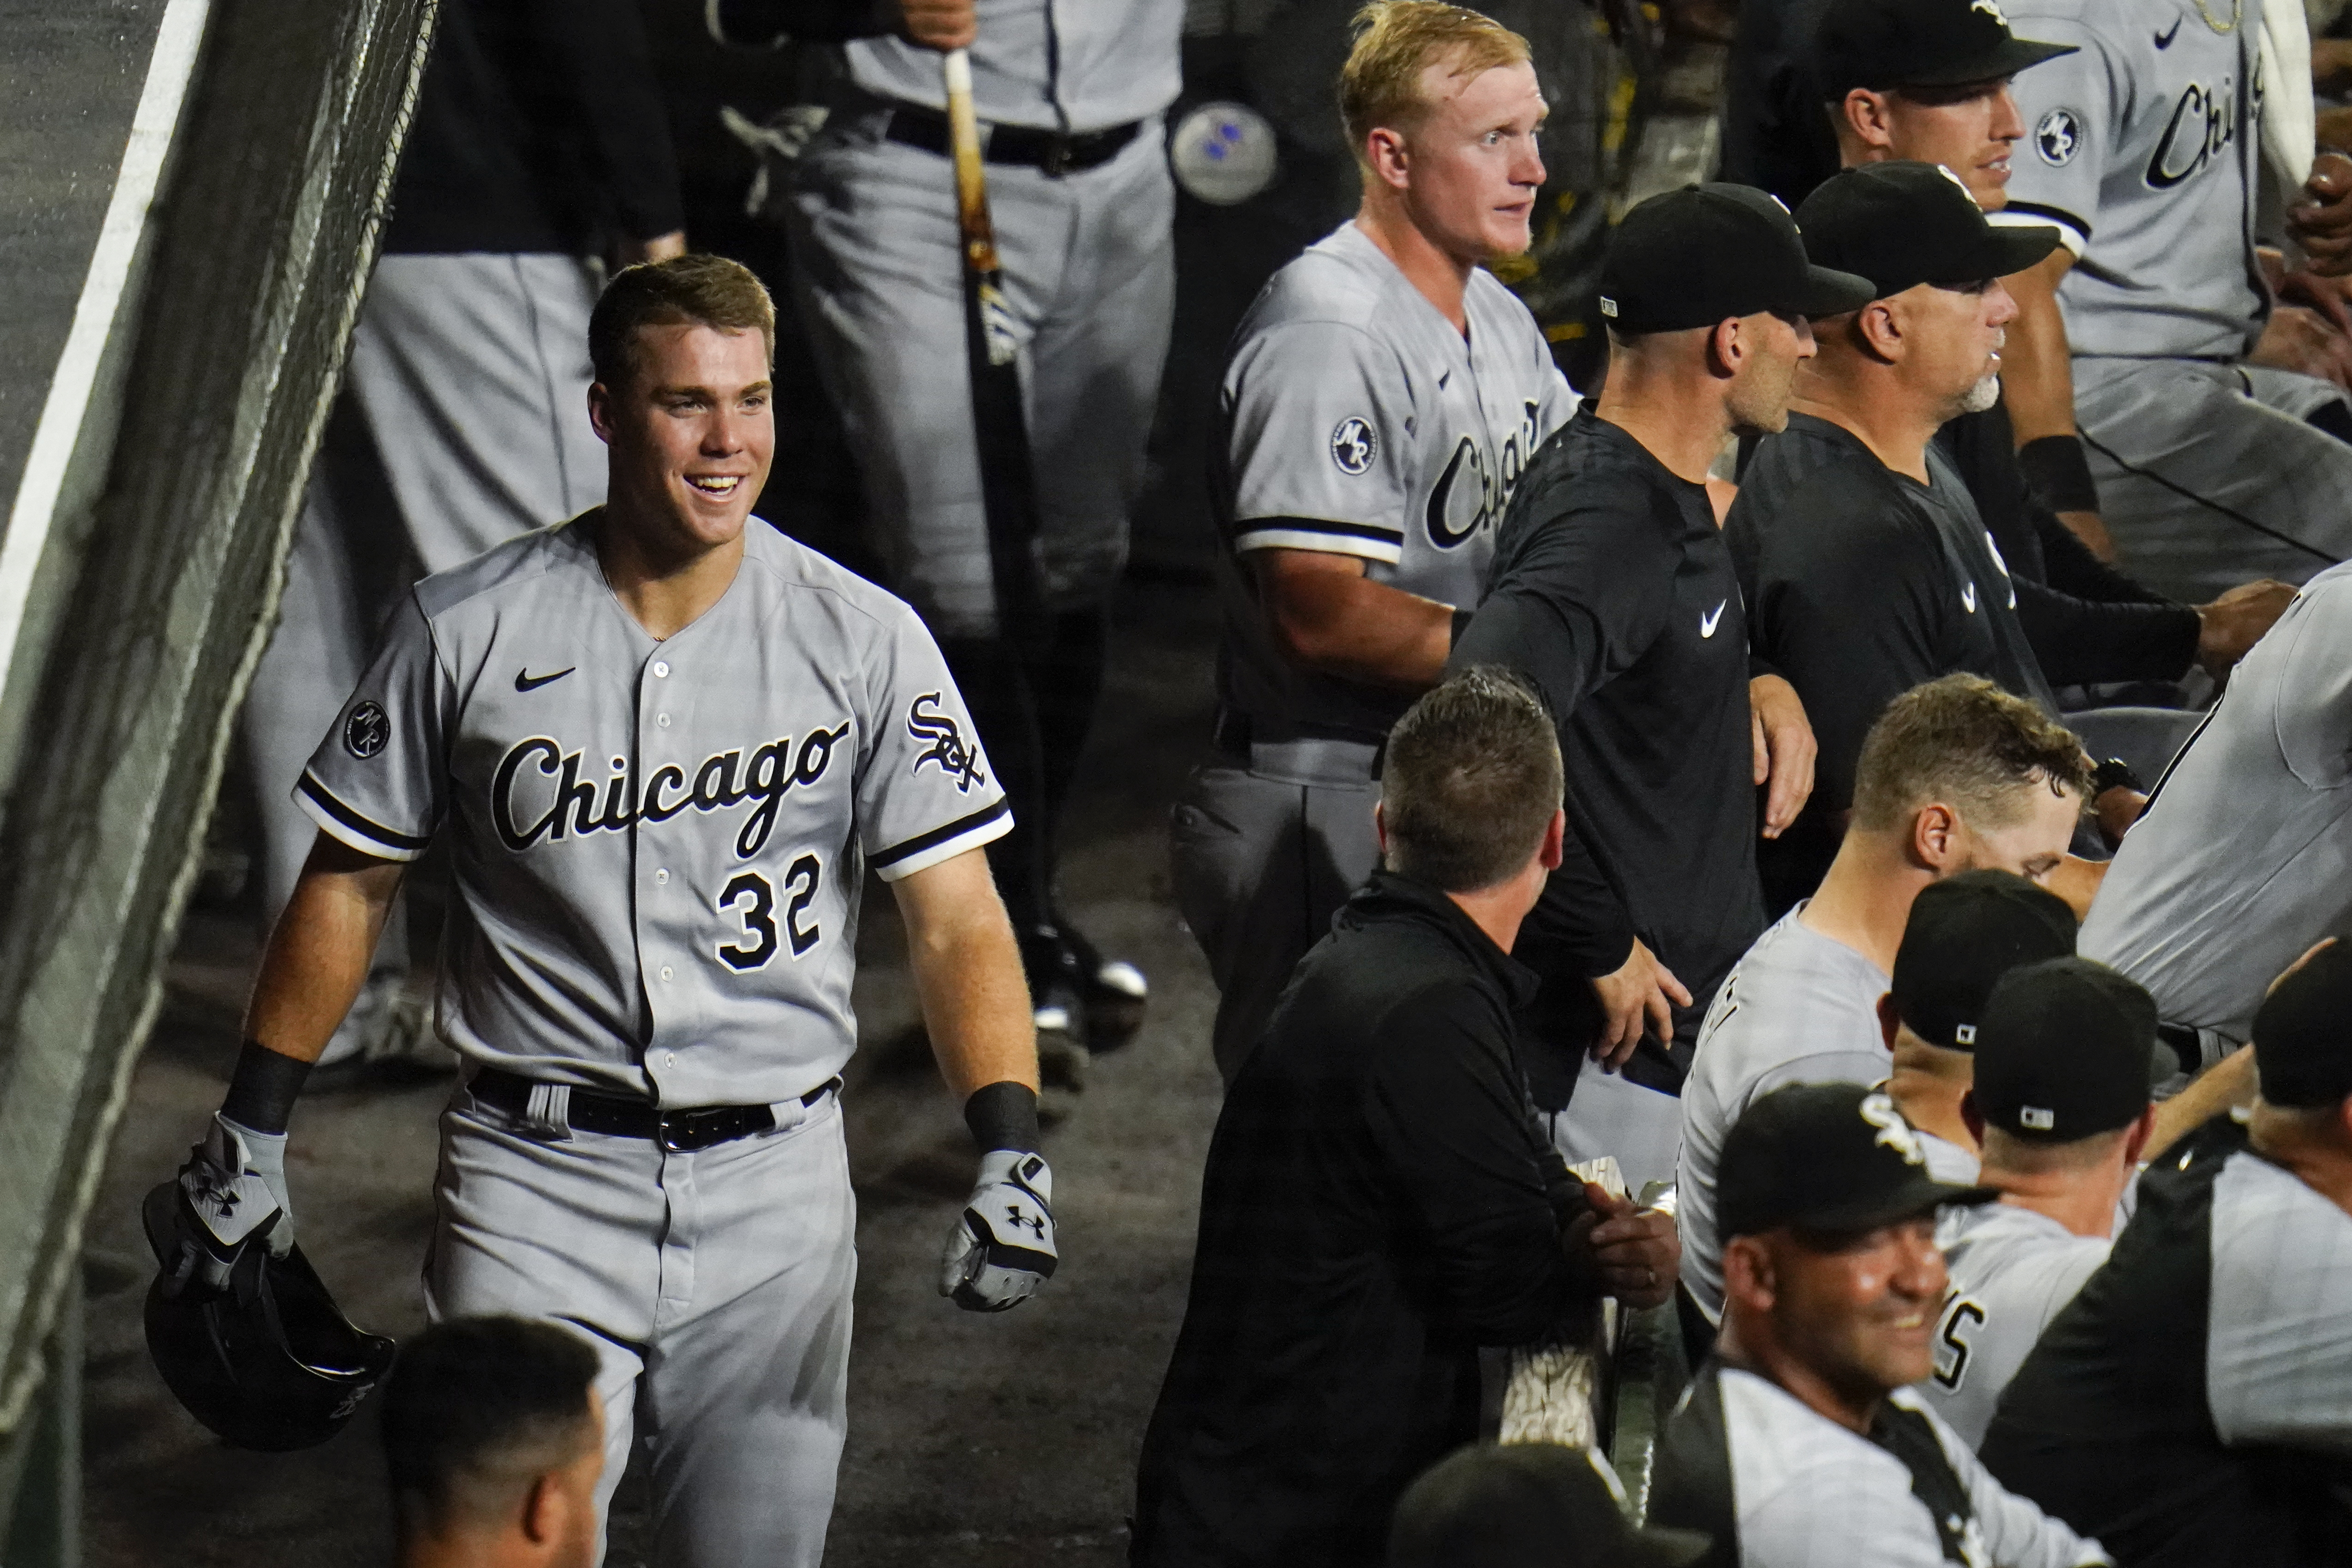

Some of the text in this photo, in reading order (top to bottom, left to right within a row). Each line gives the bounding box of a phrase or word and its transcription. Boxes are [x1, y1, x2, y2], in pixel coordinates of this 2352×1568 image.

[491, 716, 853, 861] Chicago
[906, 690, 986, 797] Sox
[715, 849, 824, 974] 32
